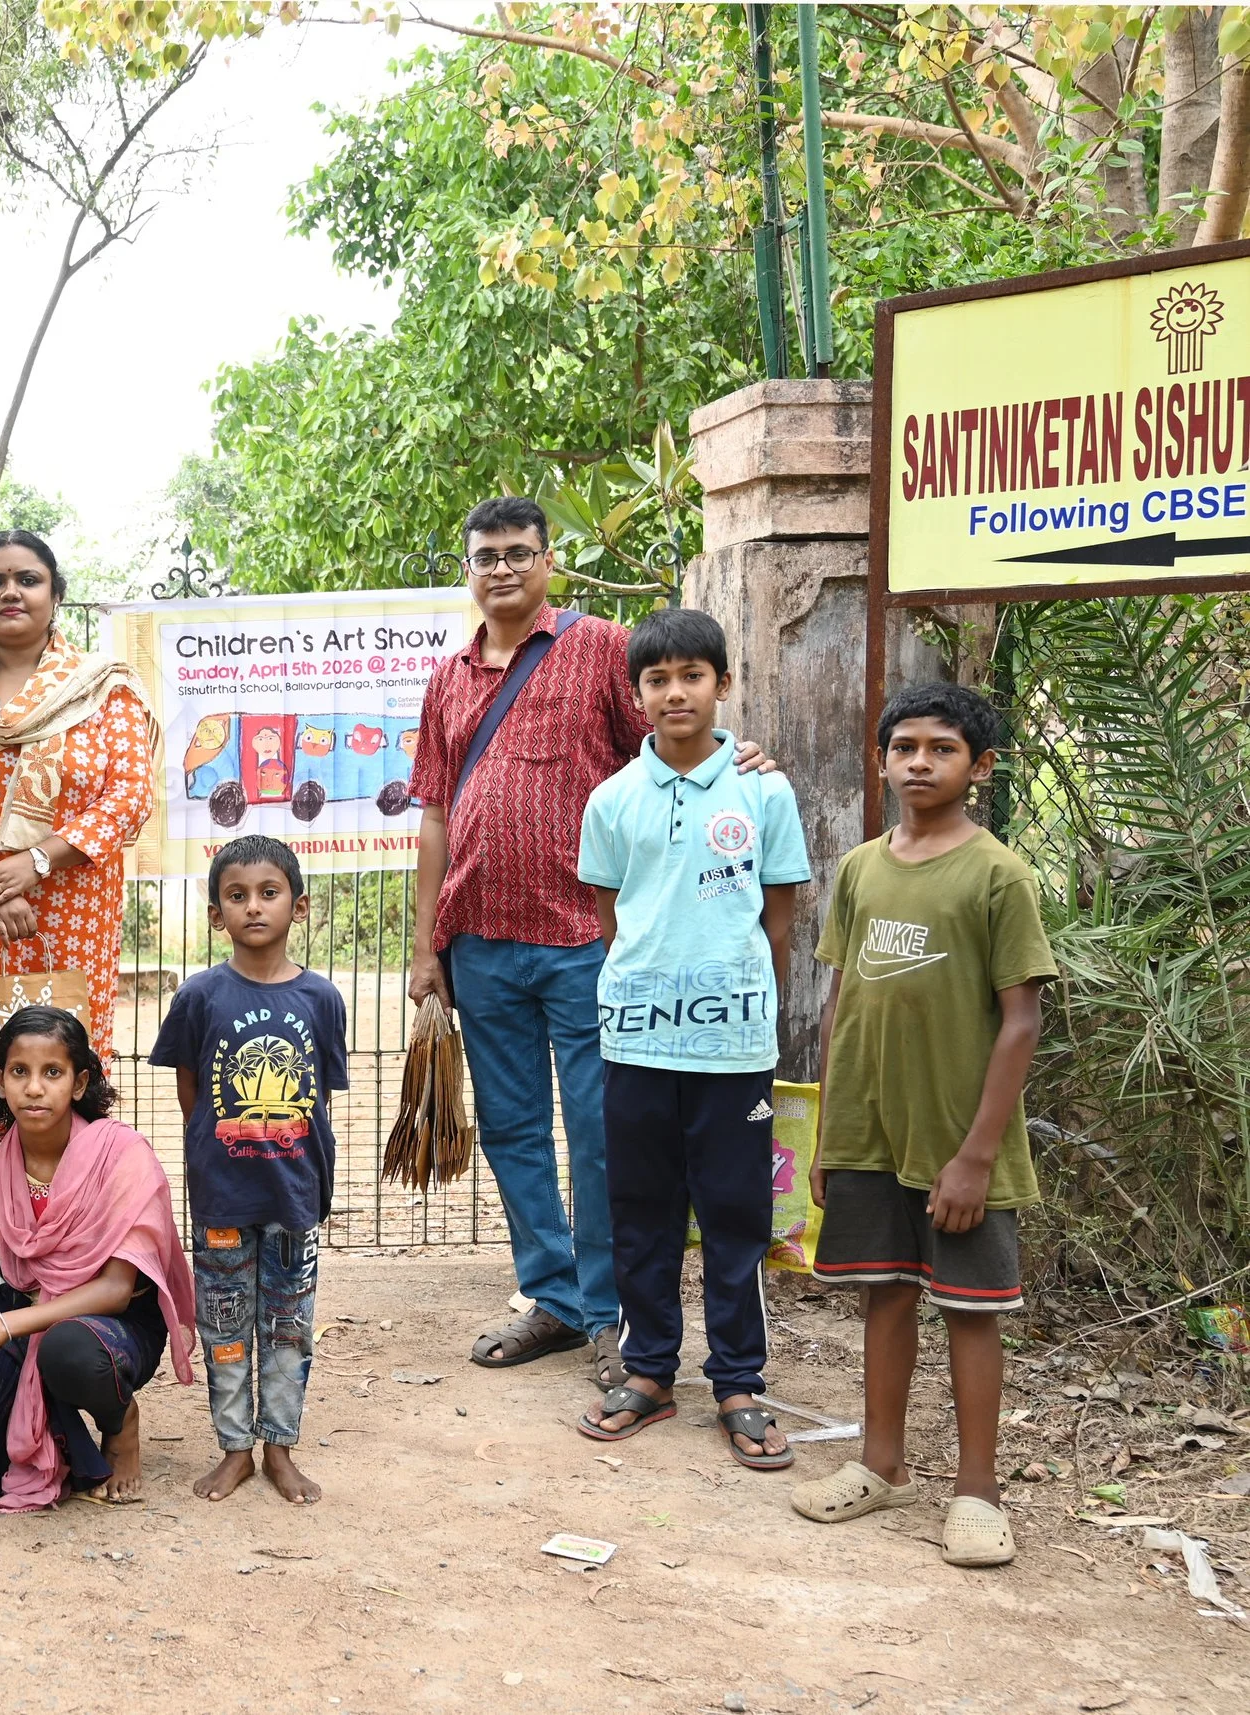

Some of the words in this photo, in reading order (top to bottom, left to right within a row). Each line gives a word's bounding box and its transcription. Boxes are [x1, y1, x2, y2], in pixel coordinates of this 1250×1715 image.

[902, 391, 1123, 501] SANTINIKETAN
[1133, 376, 1250, 481] SISHUT
[969, 497, 1129, 535] Following
[1142, 484, 1246, 522] CBSE
[176, 630, 313, 658] Children's
[323, 627, 365, 652] Art
[374, 627, 447, 650] Show
[178, 665, 244, 681] Sunday,
[249, 663, 288, 679] April
[292, 661, 317, 676] 5th
[322, 660, 363, 675] 2026
[367, 656, 386, 673] @
[391, 657, 417, 672] 2-6
[178, 685, 237, 696] Sishutirtha
[240, 683, 283, 694] School,
[285, 679, 373, 691] Ballavpurdanga,
[375, 677, 430, 688] Shantinike
[288, 838, 367, 854] ORDIALLY
[720, 824, 742, 840] 45
[702, 866, 727, 884] JUST
[732, 861, 748, 875] BE
[867, 918, 928, 957] NIKE
[211, 1039, 229, 1118] SUNSETS
[233, 1008, 272, 1033] AND
[283, 1012, 314, 1055] PALM
